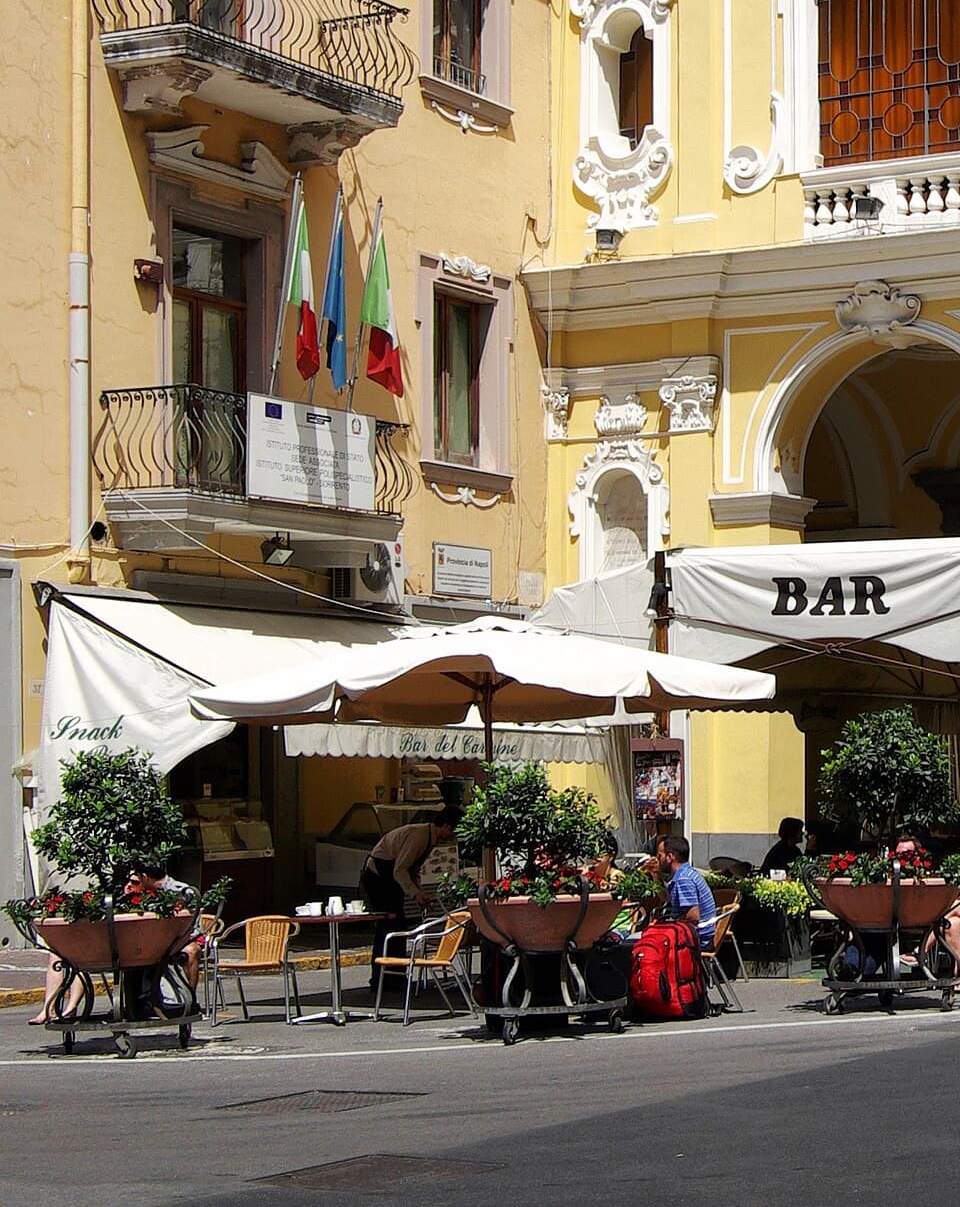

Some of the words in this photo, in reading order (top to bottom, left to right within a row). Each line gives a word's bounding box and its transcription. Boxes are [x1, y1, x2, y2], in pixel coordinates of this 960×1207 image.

[266, 440, 291, 451] ISTITUTO
[292, 444, 339, 459] PROFESSIONALE
[346, 453, 364, 462] STATO
[291, 454, 307, 464] SEDE
[309, 457, 340, 468] ASSOCIATA
[256, 459, 283, 471] ISTITUTO
[284, 463, 318, 476] SUPERIORE
[771, 575, 891, 615] BAR
[50, 714, 125, 741] Snack
[400, 733, 428, 753] Bar
[434, 734, 457, 753] del
